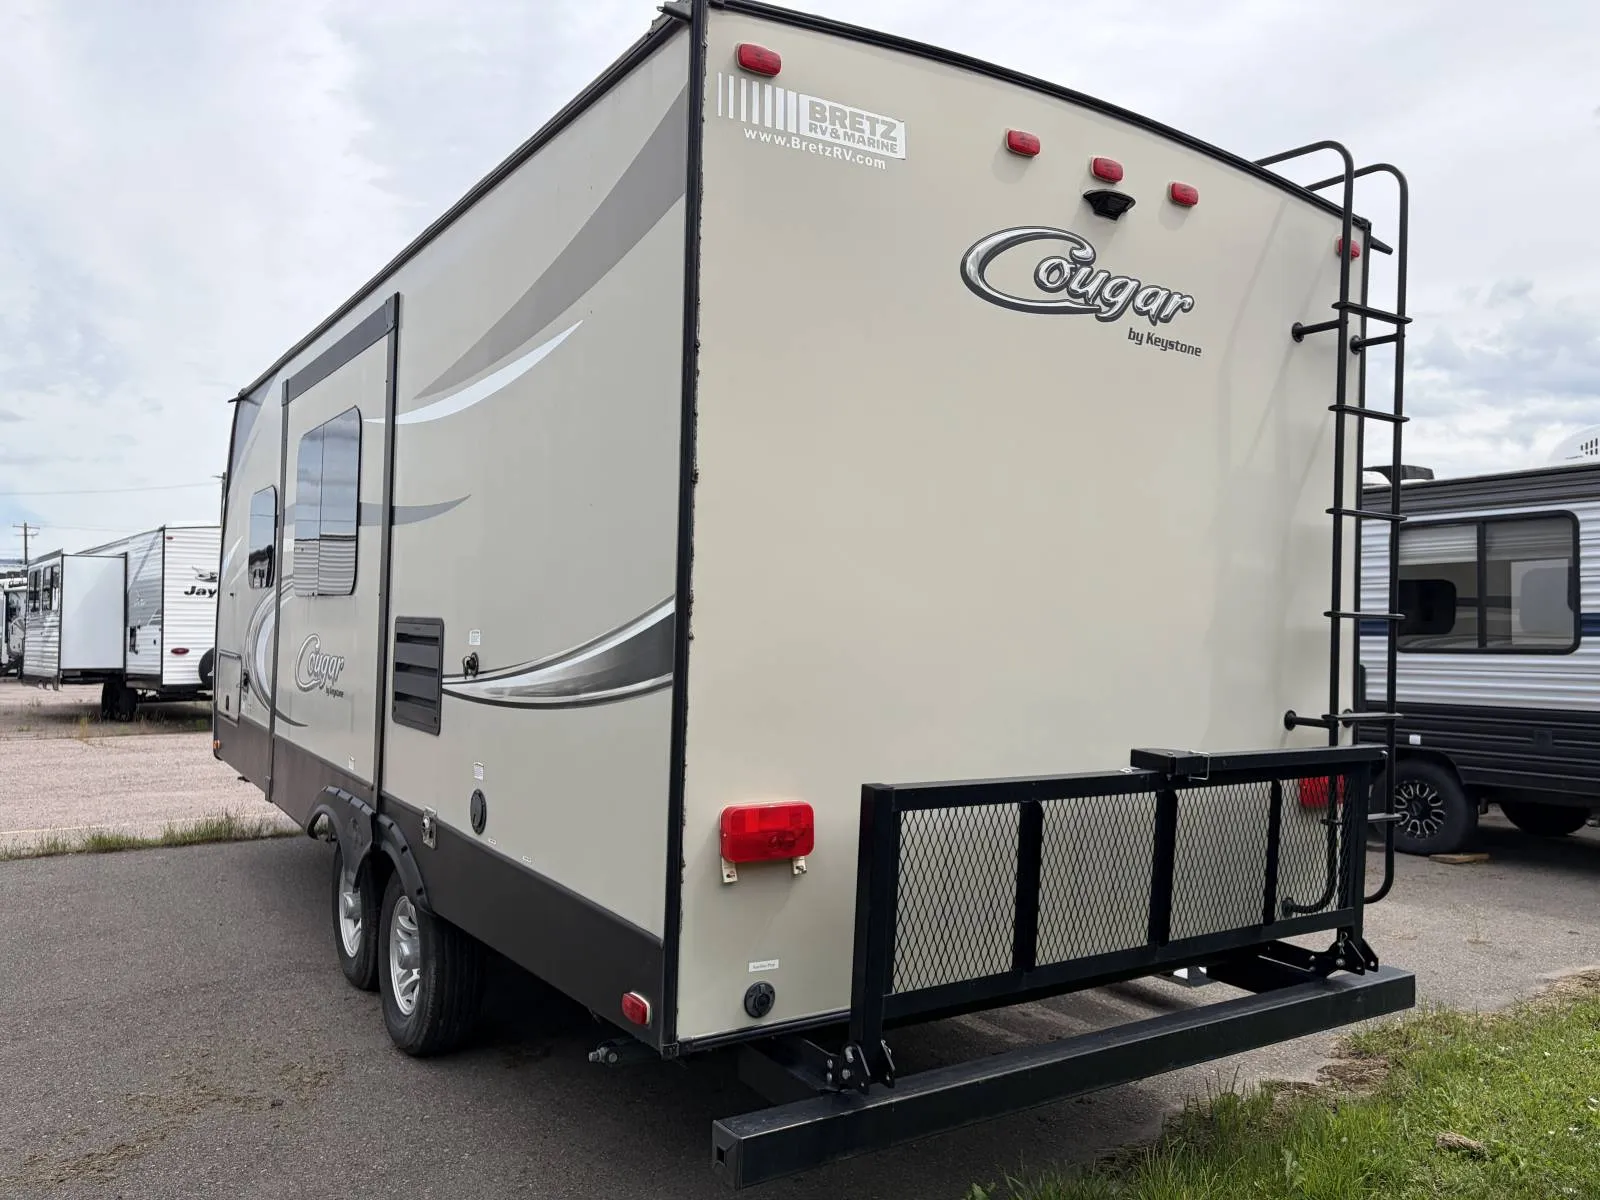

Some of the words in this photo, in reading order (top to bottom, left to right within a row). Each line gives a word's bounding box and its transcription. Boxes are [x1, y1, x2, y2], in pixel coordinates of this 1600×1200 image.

[808, 100, 898, 142] BRETZ
[808, 122, 833, 136] RV
[830, 128, 841, 140] &
[843, 130, 898, 154] MARINE
[743, 128, 887, 170] www.BretzRV.com
[961, 225, 1195, 326] Cougar
[1128, 327, 1144, 345] by
[1145, 332, 1202, 357] Keystone
[295, 633, 344, 692] Cougar
